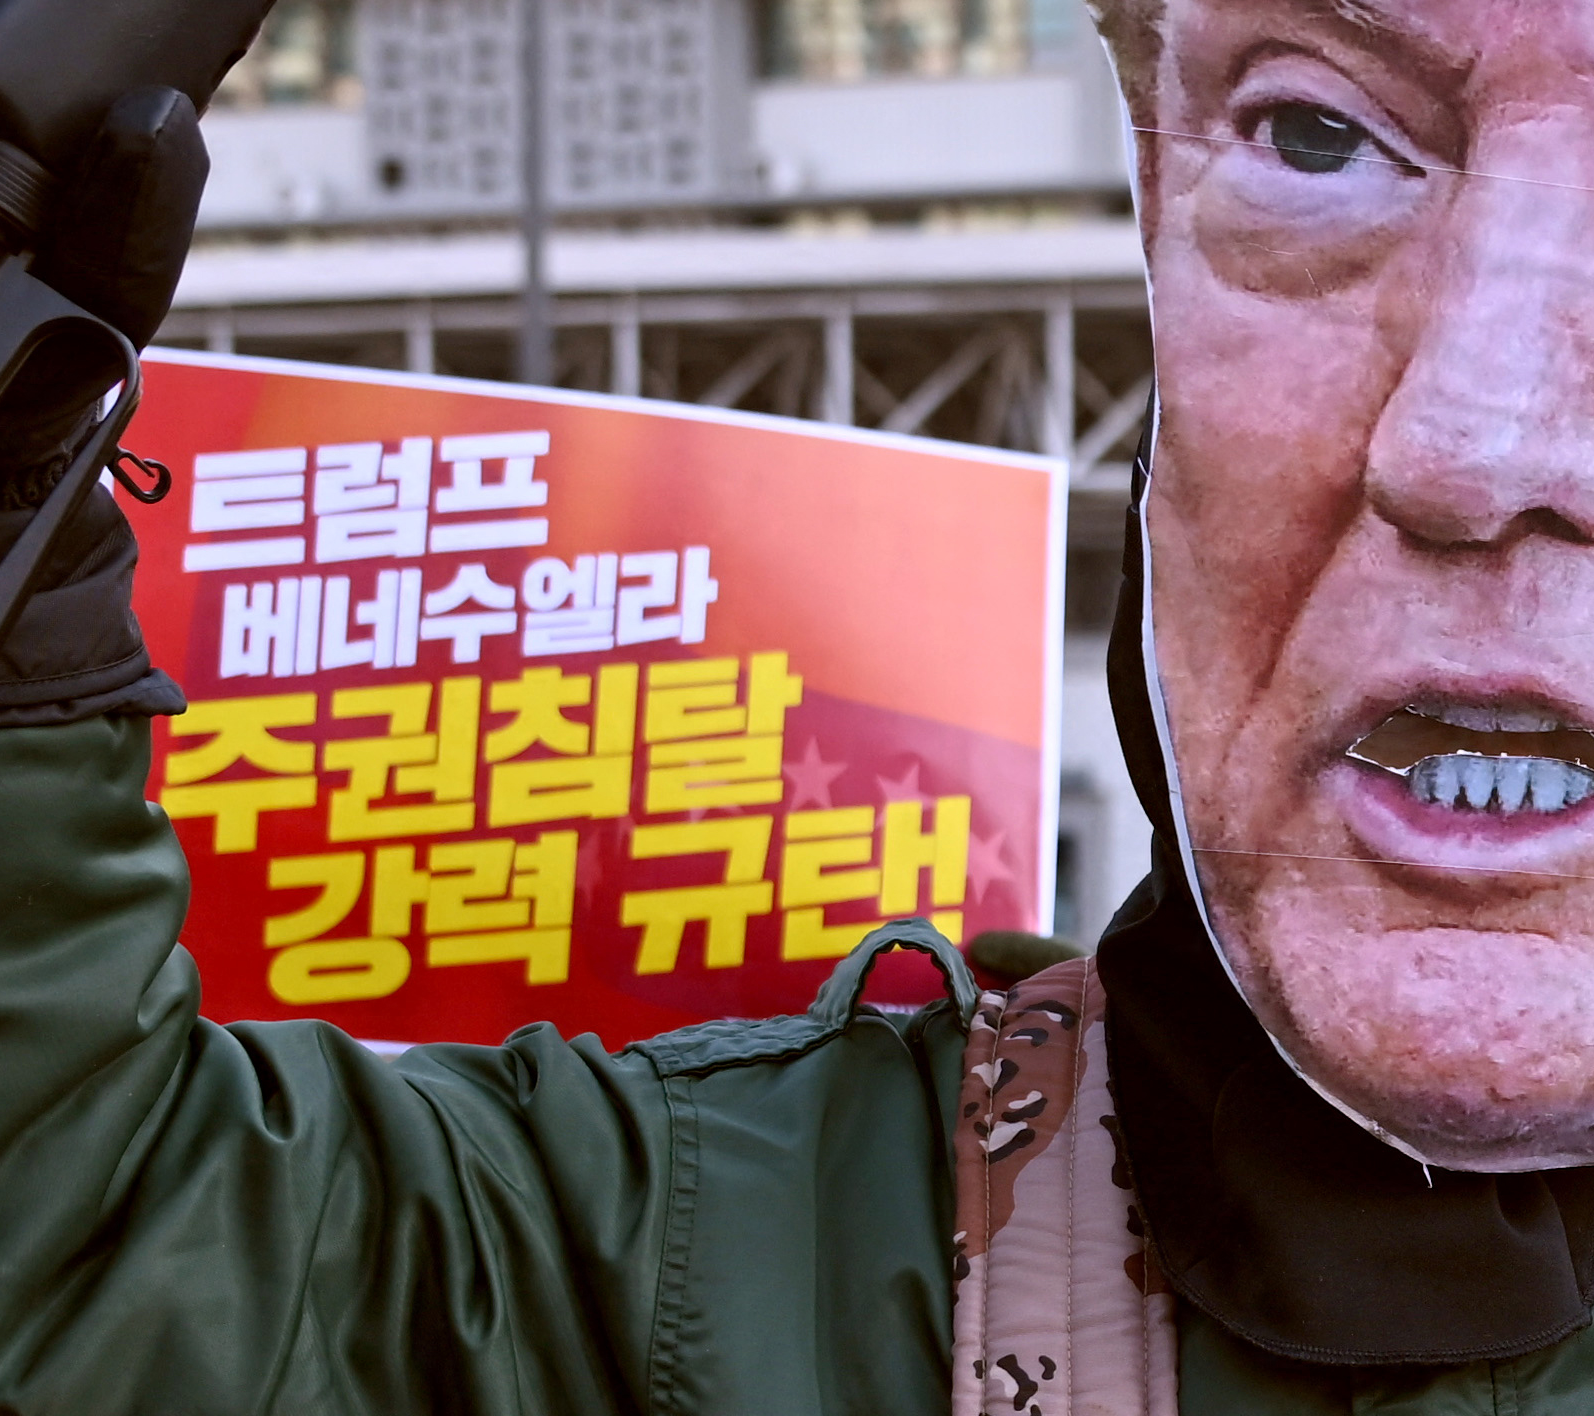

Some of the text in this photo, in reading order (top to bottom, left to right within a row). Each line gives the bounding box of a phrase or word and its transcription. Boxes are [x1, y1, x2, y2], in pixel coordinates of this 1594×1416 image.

[183, 431, 550, 571] 트럼프
[219, 546, 719, 678] 베네수엘라
[160, 650, 804, 855] 주권침탈
[264, 830, 579, 1006] 강력
